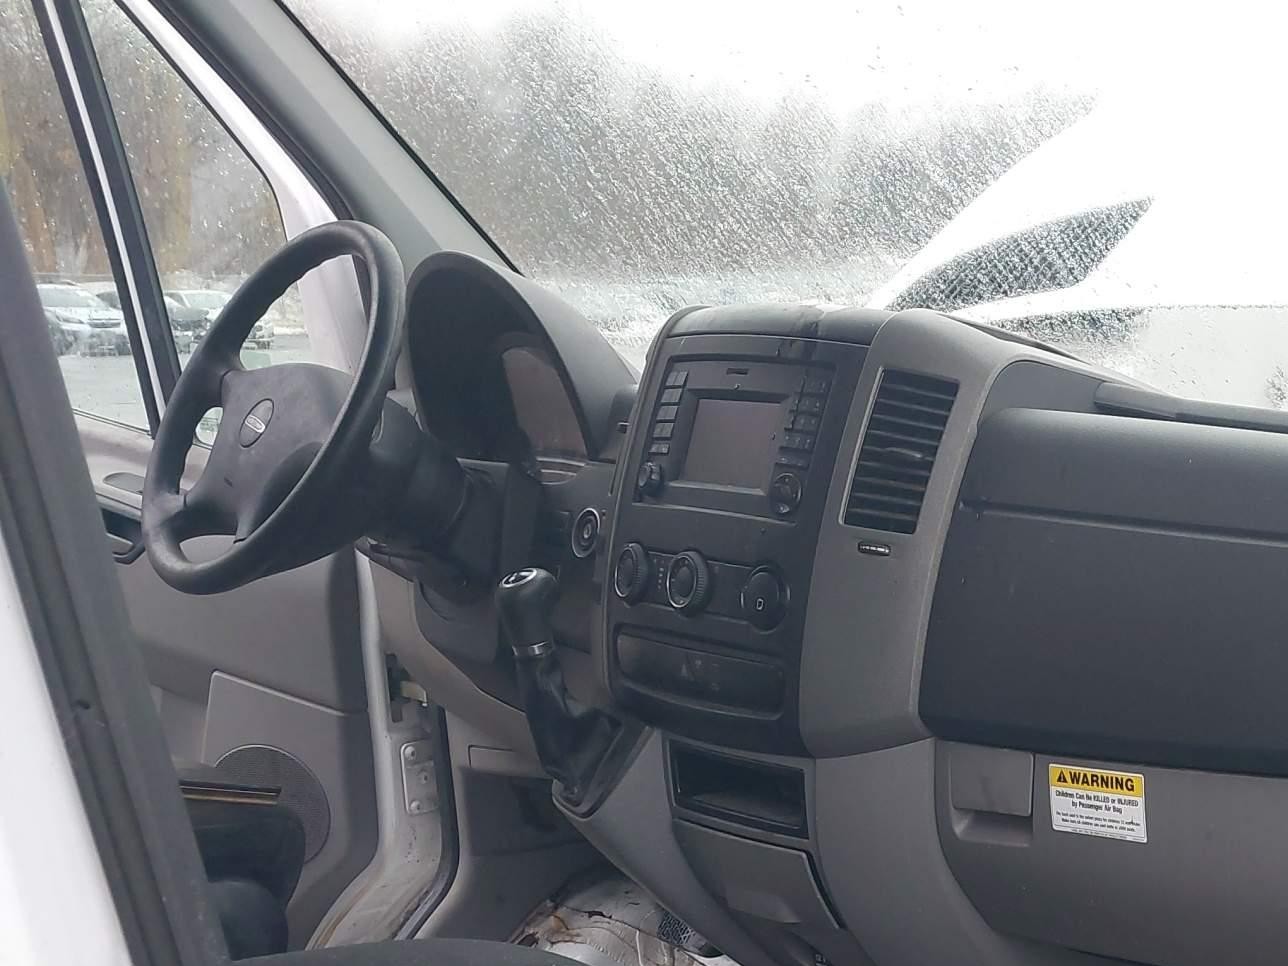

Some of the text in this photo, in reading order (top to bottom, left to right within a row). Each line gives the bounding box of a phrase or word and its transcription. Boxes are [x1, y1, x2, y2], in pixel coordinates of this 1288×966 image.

[1068, 770, 1135, 792] WARNING
[1055, 789, 1075, 798] Children
[1076, 792, 1086, 800] Can
[1093, 794, 1110, 803] KILLED
[1117, 798, 1139, 807] INJURED
[1072, 800, 1078, 808] by
[1079, 801, 1103, 811] Passenger
[1112, 805, 1122, 814] Bag
